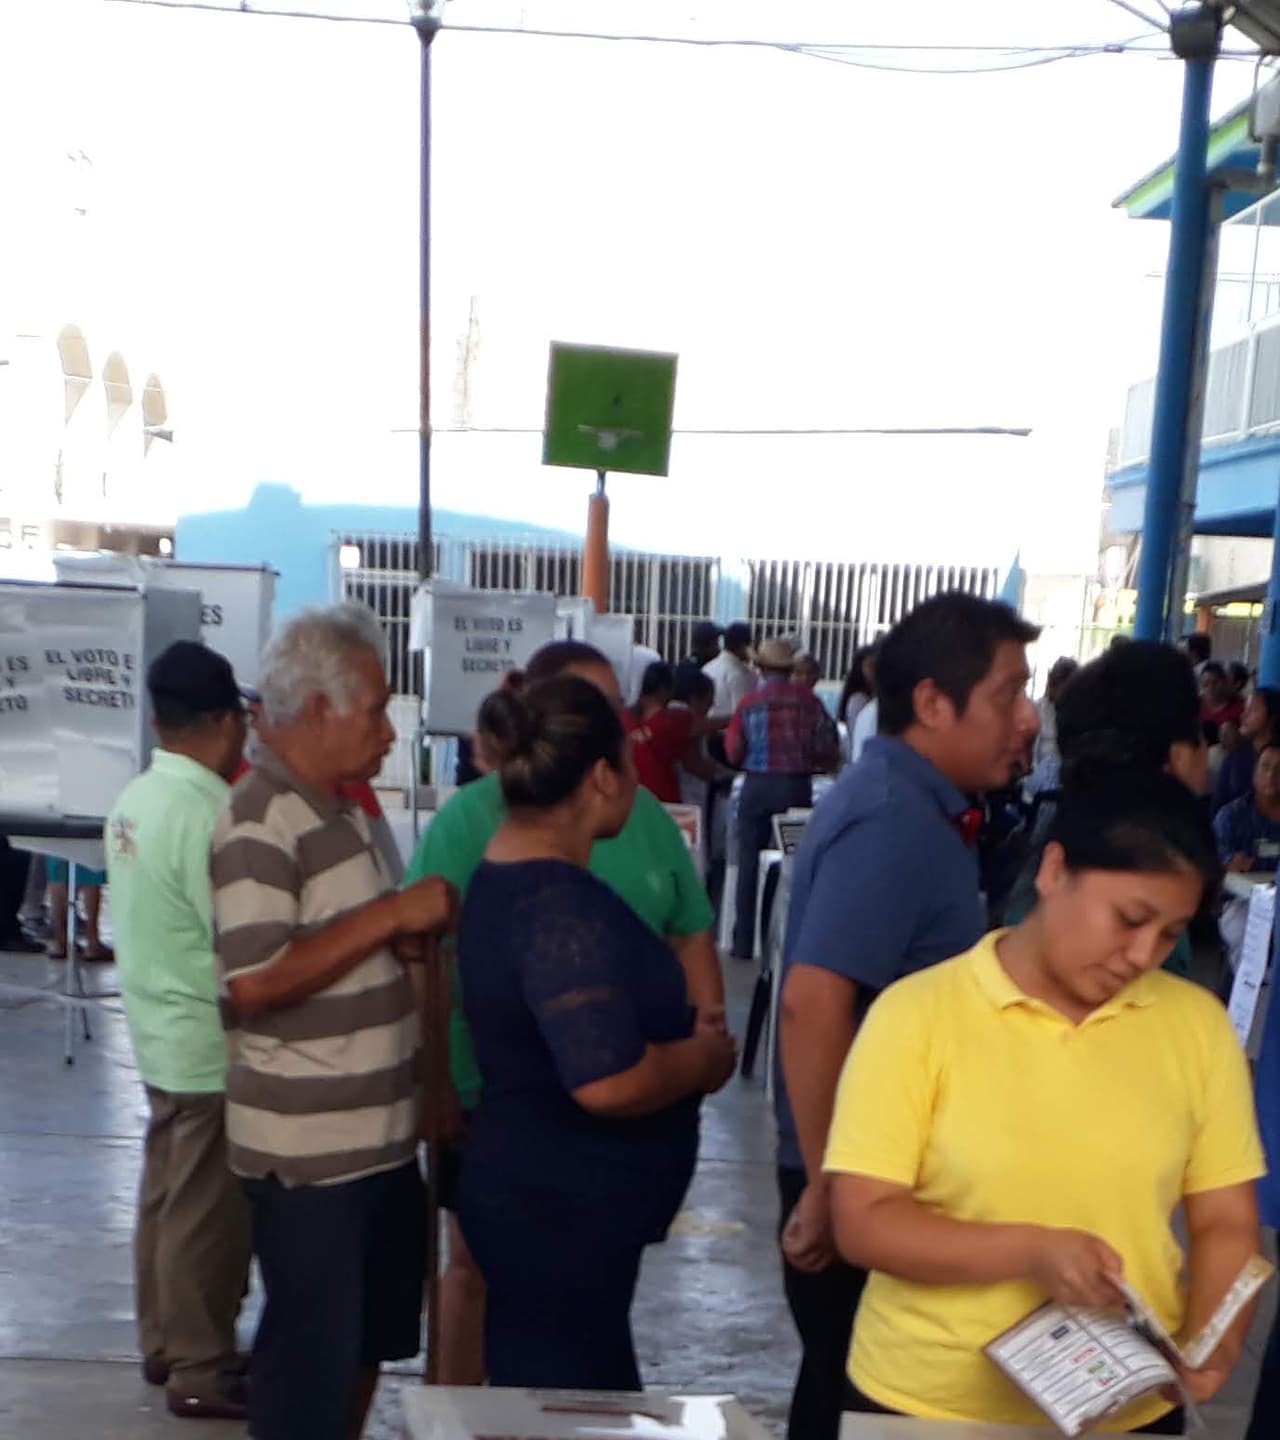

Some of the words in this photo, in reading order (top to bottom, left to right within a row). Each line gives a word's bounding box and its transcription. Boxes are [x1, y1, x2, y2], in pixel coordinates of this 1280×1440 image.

[200, 604, 223, 626] ES
[8, 656, 31, 672] ES
[43, 649, 67, 665] EL
[72, 648, 119, 667] VOTO
[66, 667, 116, 685] LIBRE
